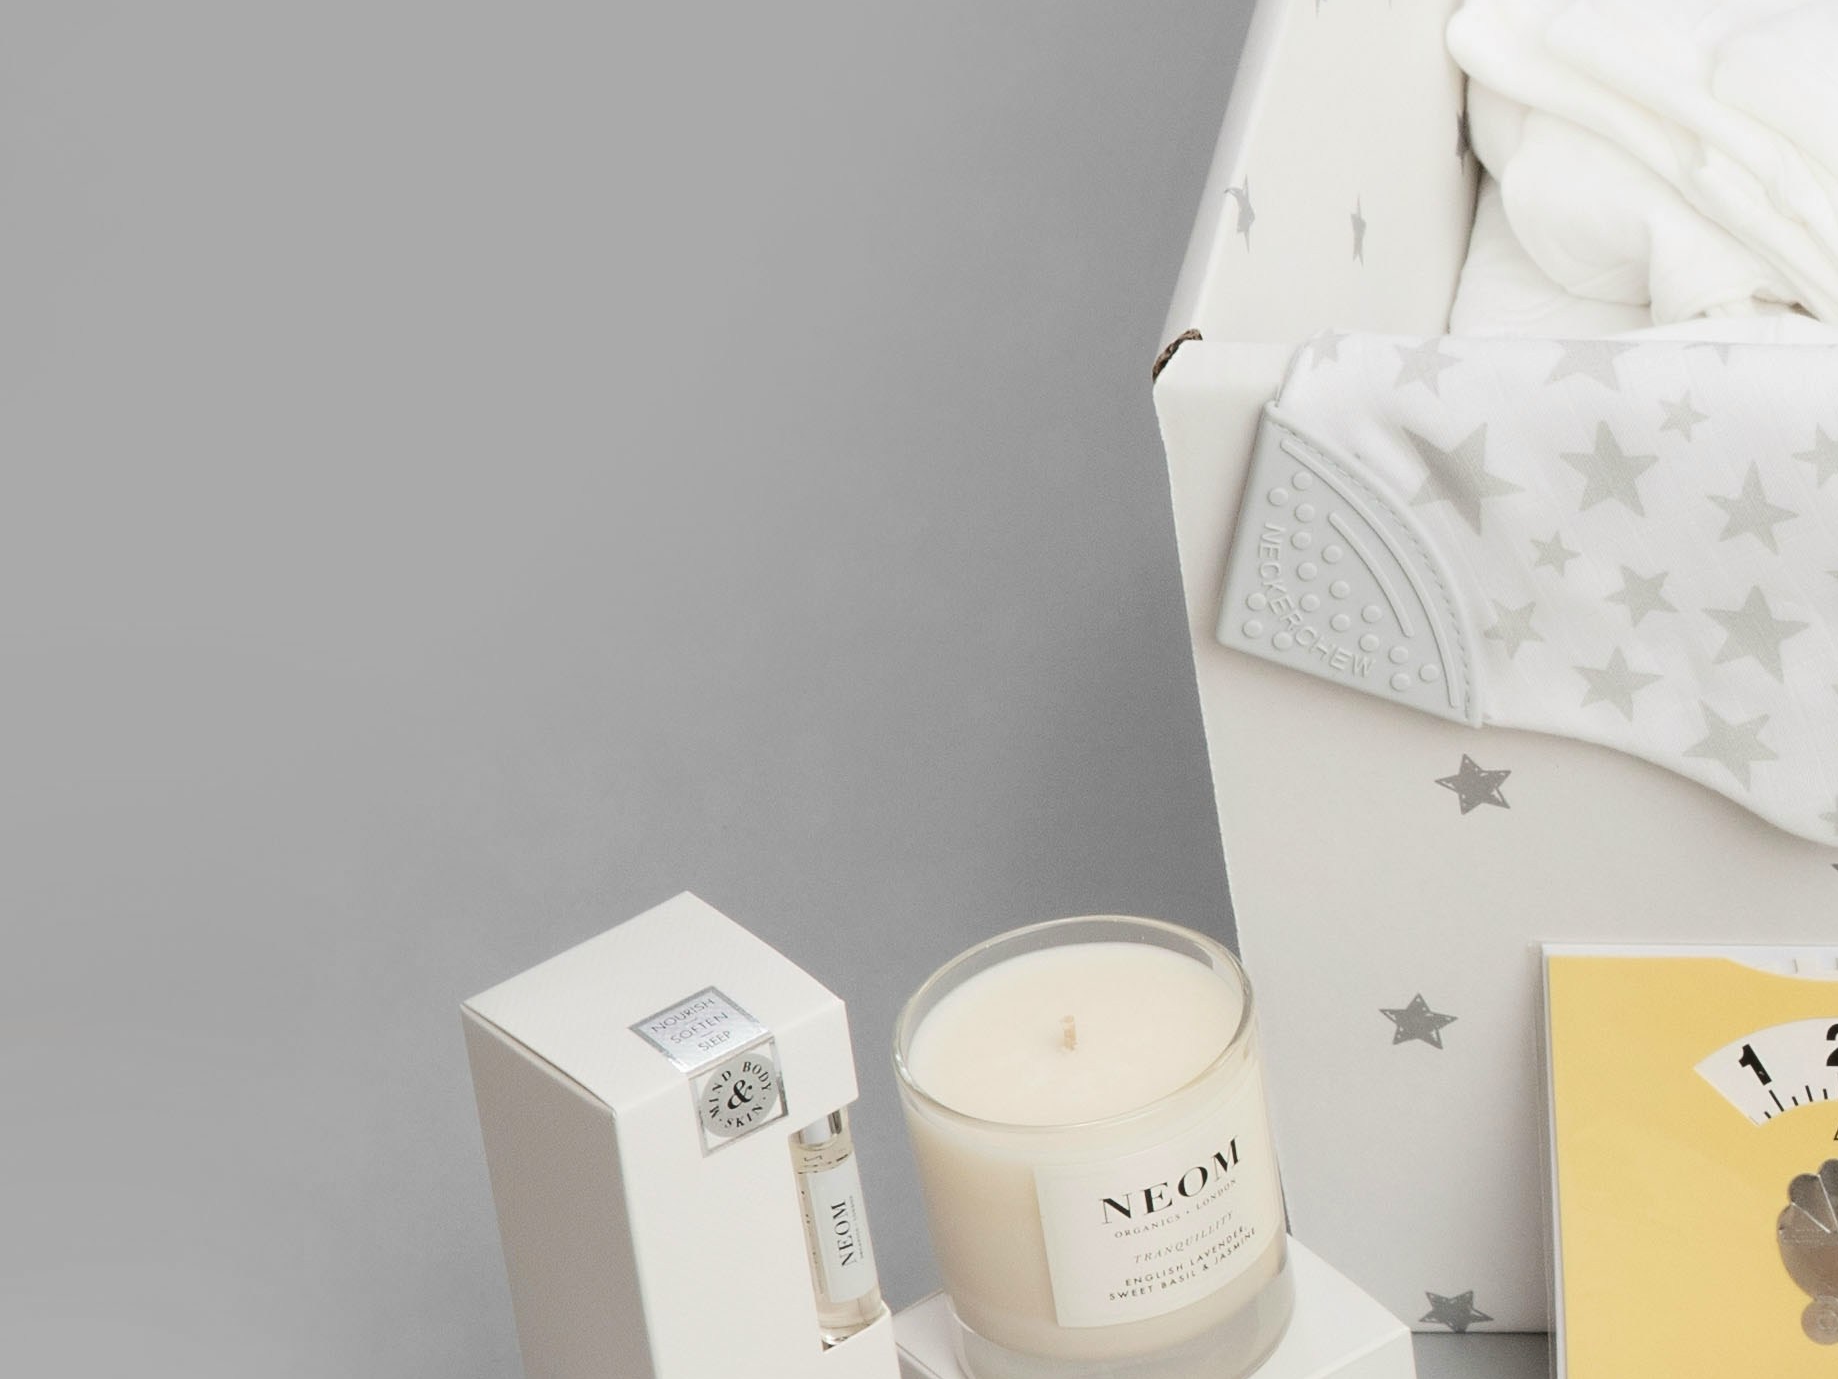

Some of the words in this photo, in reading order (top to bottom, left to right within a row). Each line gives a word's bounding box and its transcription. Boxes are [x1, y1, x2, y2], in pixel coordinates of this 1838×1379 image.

[1259, 523, 1376, 677] NECKERCHEW
[651, 998, 715, 1033] NOURISH
[670, 1012, 728, 1044] SOFTEN
[697, 1030, 732, 1051] SLEEP
[742, 1061, 772, 1091] BODY
[1738, 1043, 1773, 1086] 1
[725, 1104, 763, 1128] SKIN
[1099, 1135, 1241, 1224] NEOM
[1114, 1214, 1180, 1239] ORGANICS
[1196, 1179, 1236, 1210] LONDON
[831, 1201, 857, 1266] NEOM
[1135, 1211, 1233, 1264] TRANQUILLITY
[1110, 1285, 1153, 1301] SWEET
[1161, 1271, 1196, 1289] BASIL
[1215, 1227, 1256, 1264] JASMINE
[1126, 1264, 1183, 1286] ENGLISH
